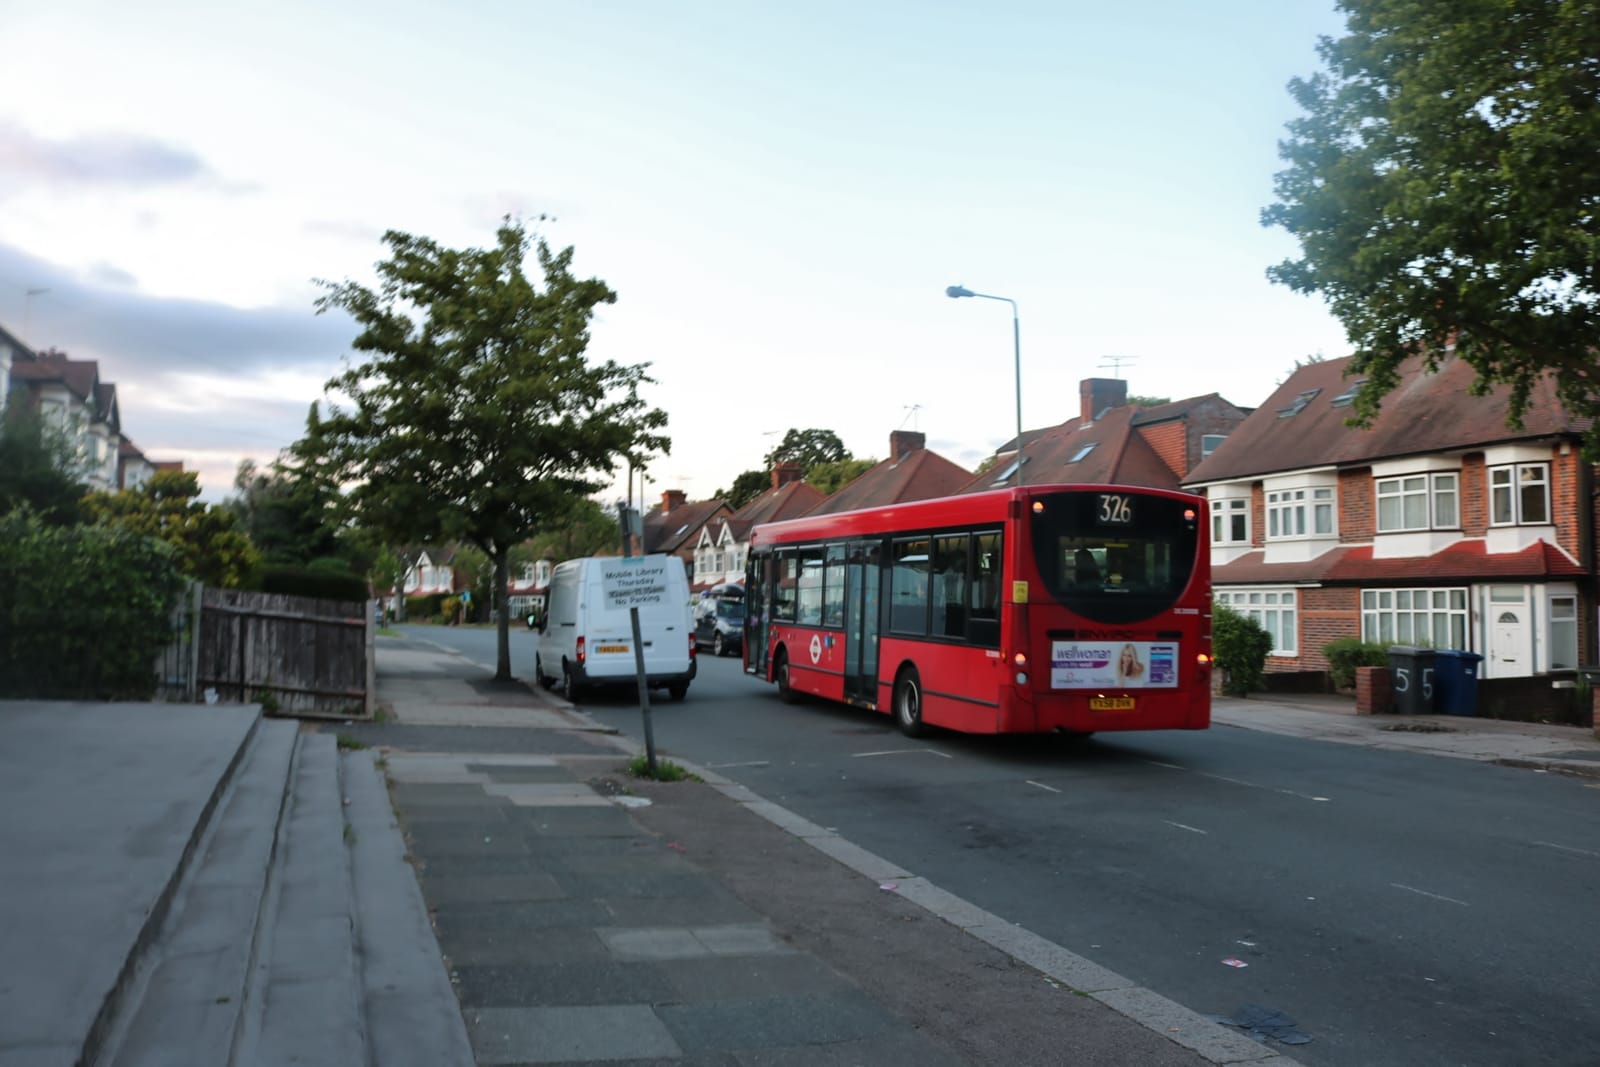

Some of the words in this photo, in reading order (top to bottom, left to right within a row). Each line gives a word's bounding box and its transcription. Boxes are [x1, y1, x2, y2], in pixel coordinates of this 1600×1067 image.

[1100, 495, 1131, 522] 326
[605, 570, 632, 579] Mobile
[635, 568, 664, 577] Library
[617, 578, 654, 587] Thursday
[630, 595, 660, 604] Parking
[1056, 646, 1111, 659] wellwoman
[1395, 667, 1409, 692] 5
[1423, 668, 1434, 699] 5
